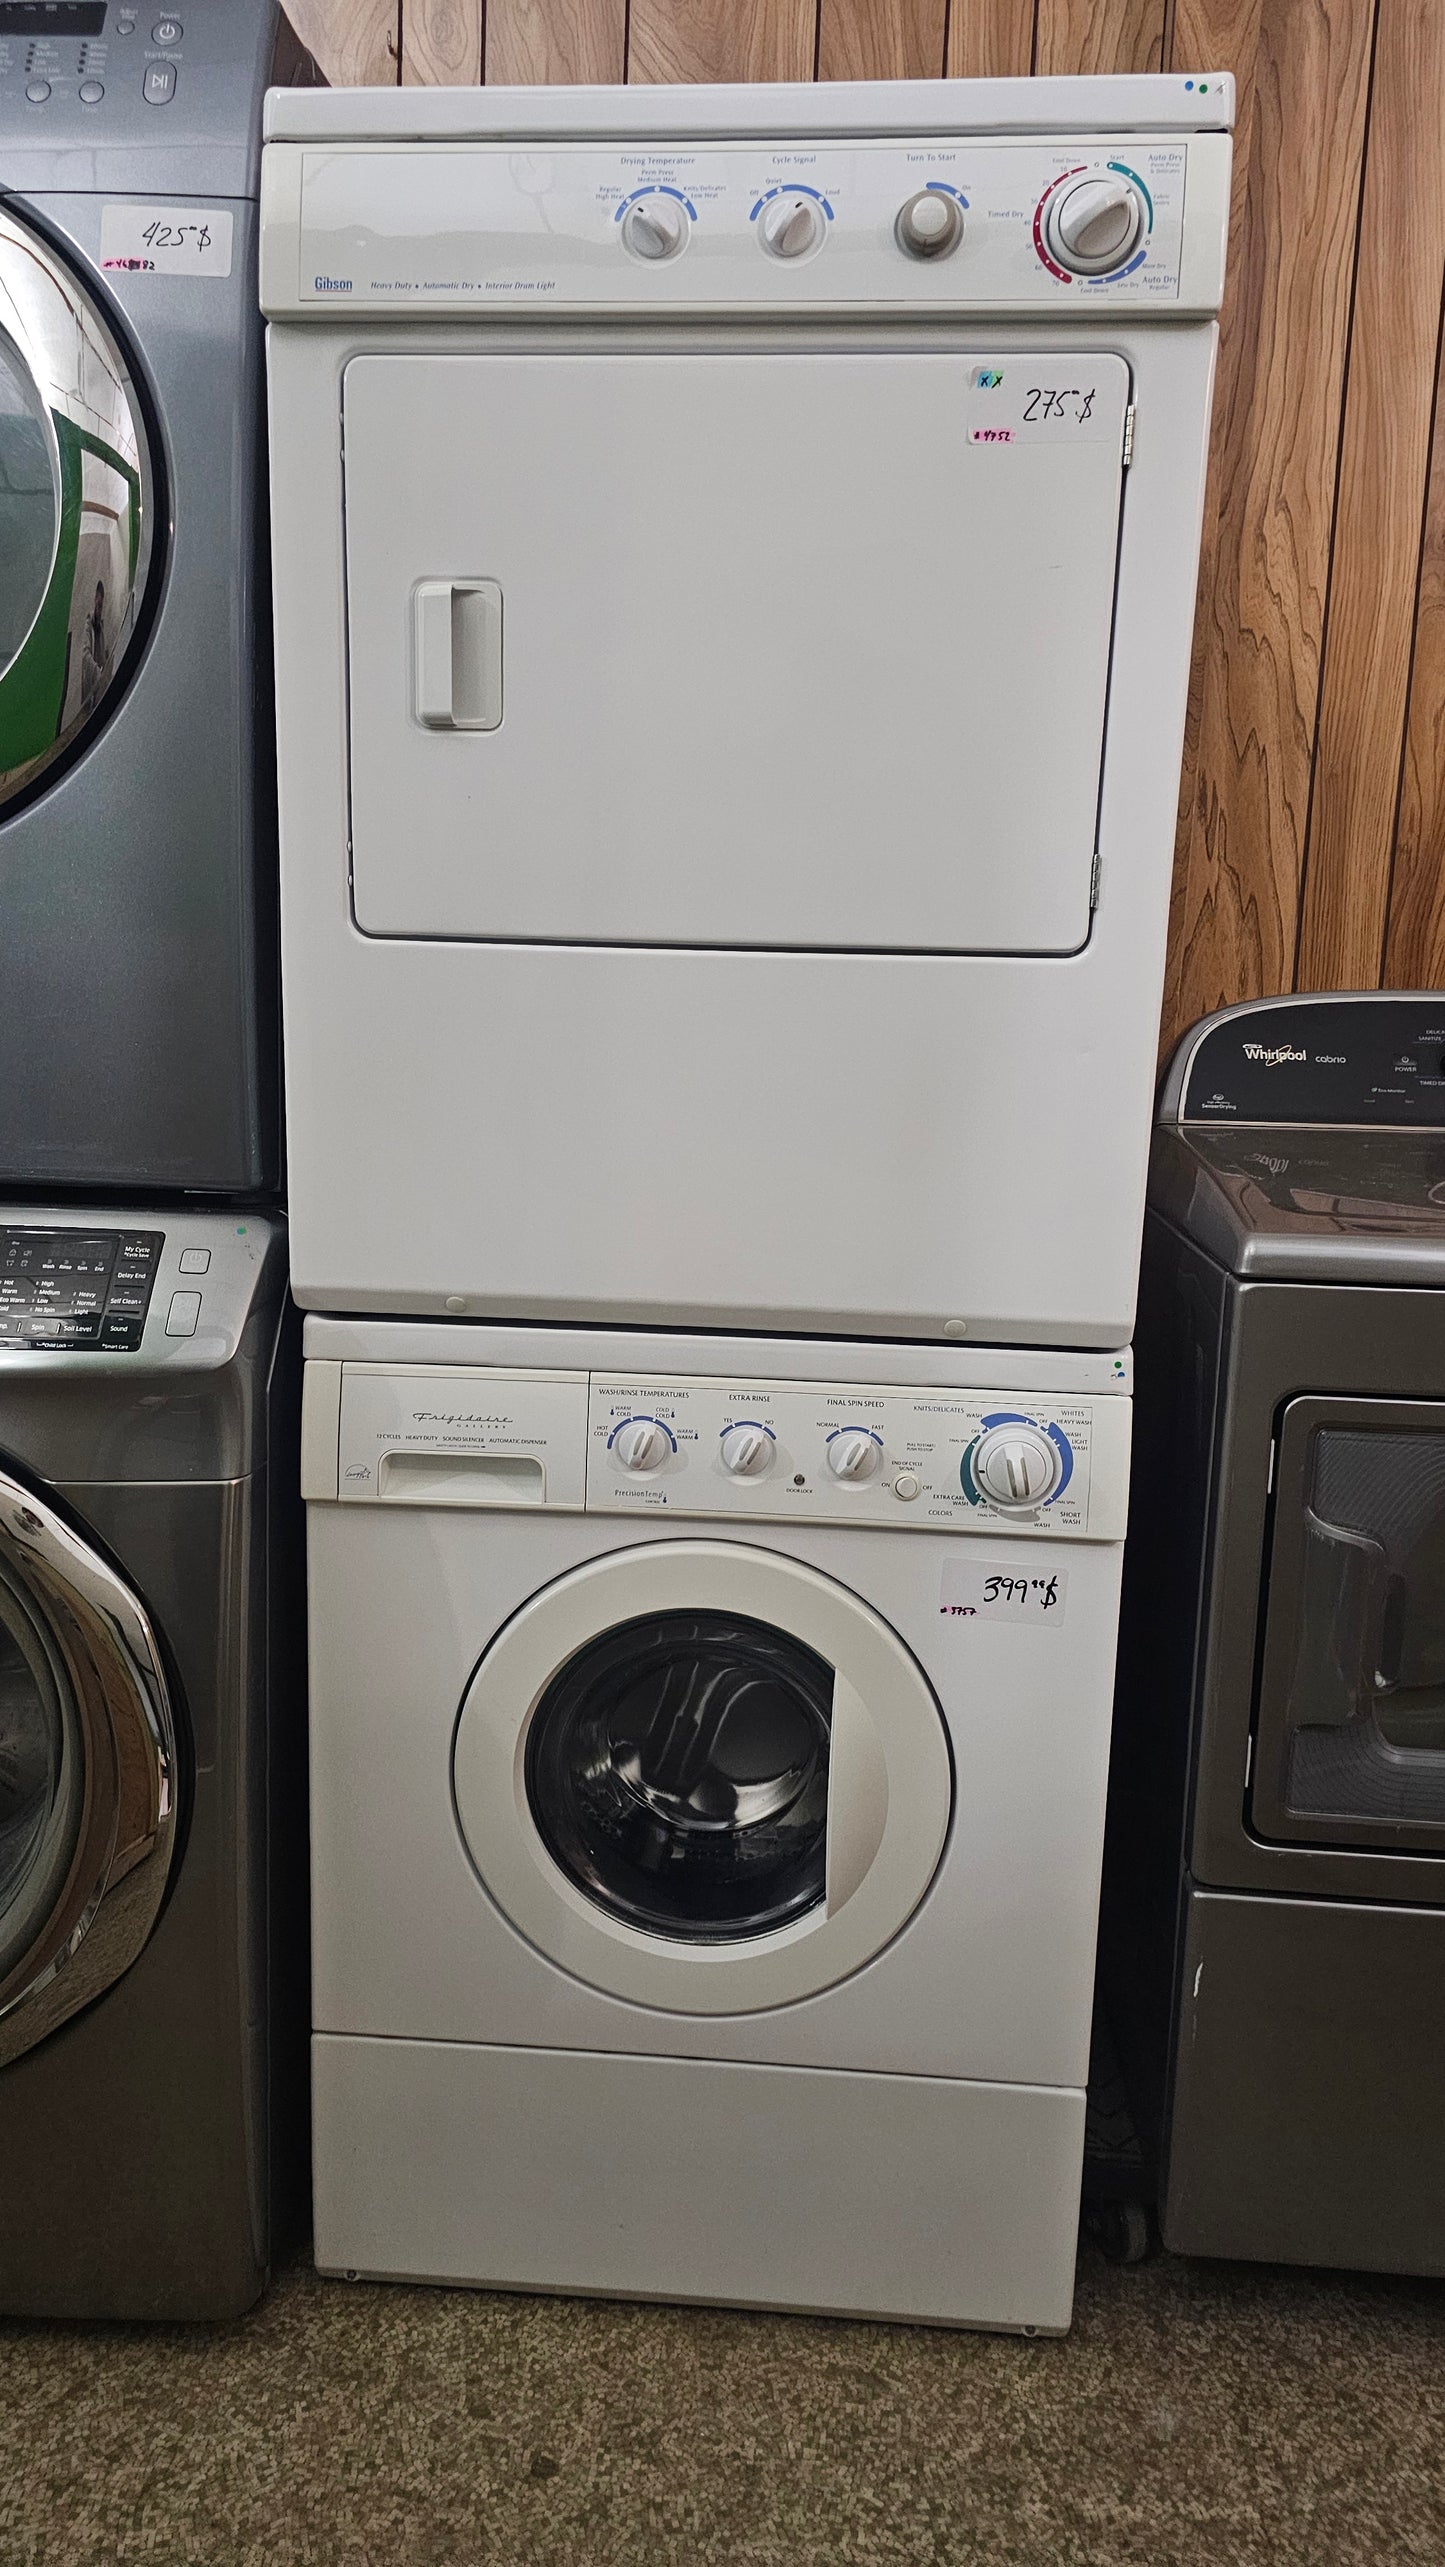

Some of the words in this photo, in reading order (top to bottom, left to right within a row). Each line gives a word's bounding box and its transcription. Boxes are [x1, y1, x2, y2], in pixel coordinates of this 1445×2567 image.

[621, 157, 646, 165] Drying
[648, 157, 696, 165] Temperature
[772, 156, 792, 164] Cycle
[794, 155, 816, 164] Signal
[1169, 154, 1183, 162] Dry
[1009, 211, 1024, 219] Dry
[314, 276, 353, 289] Gibson
[1164, 276, 1177, 284] Dry
[371, 282, 392, 290] Heavy
[394, 282, 412, 290] Duty
[461, 282, 474, 290] Dry
[536, 282, 555, 290] Light
[1244, 1048, 1307, 1063] Whirlpool
[1315, 1055, 1346, 1063] cabrio
[599, 1388, 638, 1397] WASH/RINSE
[640, 1390, 689, 1399] TEMPERATURES
[864, 1400, 885, 1408] SPEED
[412, 1412, 513, 1424] Frigidaire
